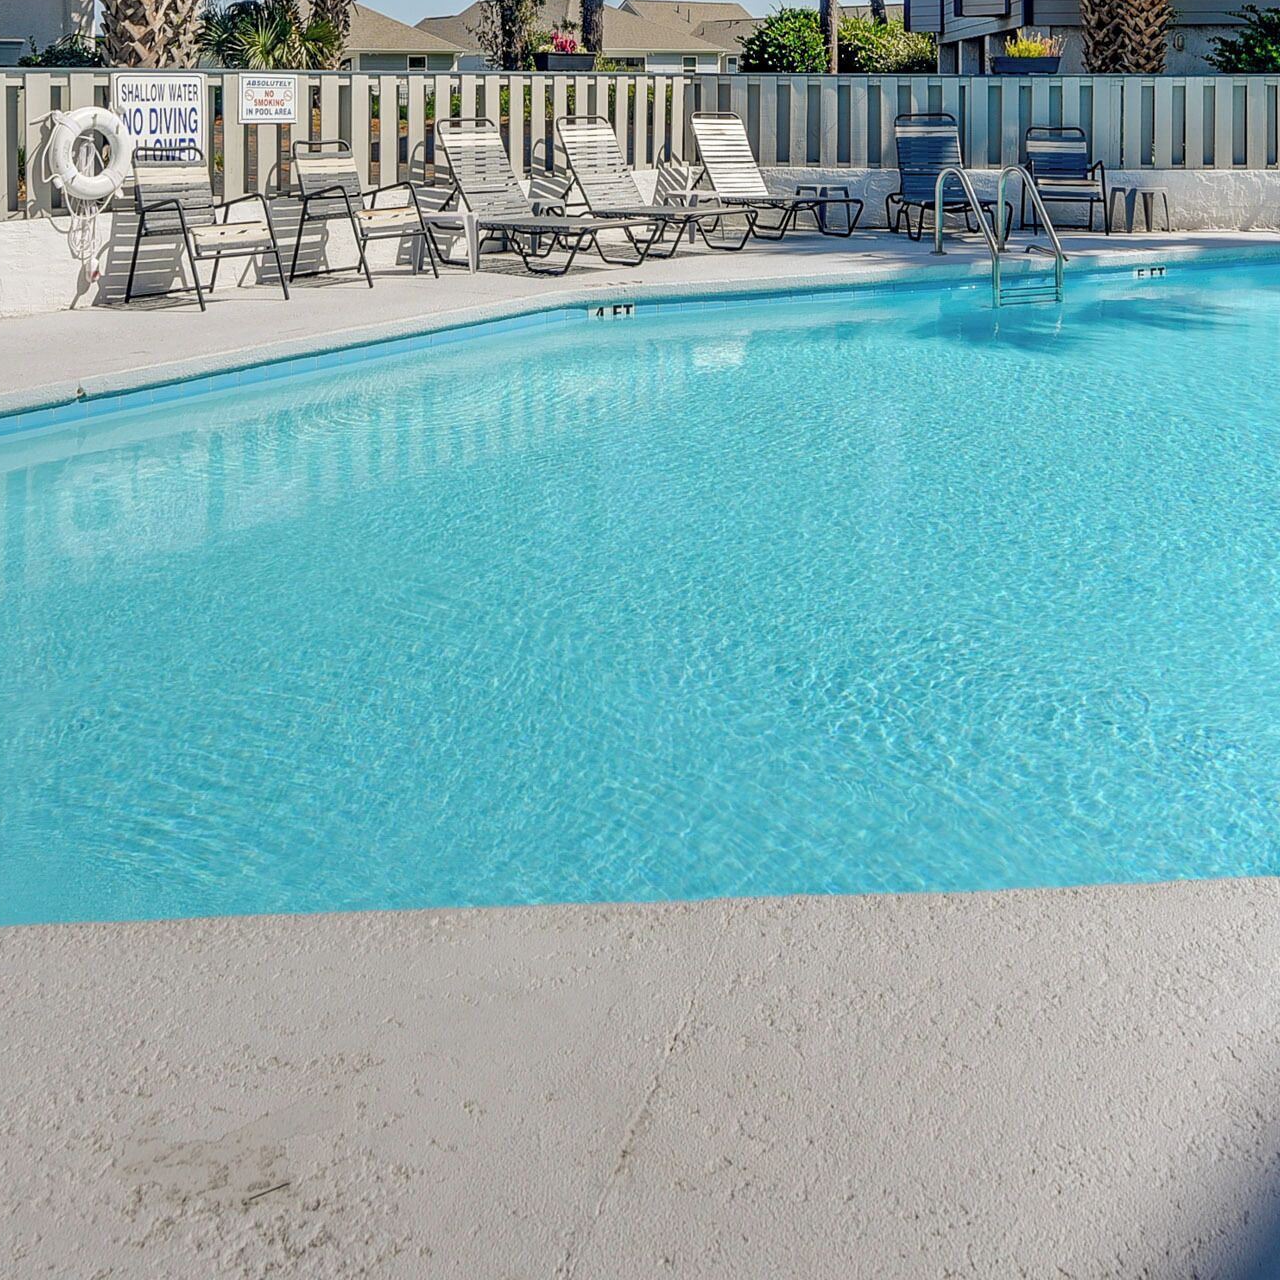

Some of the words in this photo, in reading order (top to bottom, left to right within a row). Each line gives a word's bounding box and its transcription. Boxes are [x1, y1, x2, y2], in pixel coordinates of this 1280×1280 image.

[121, 83, 164, 102] SHALLOW
[169, 83, 199, 102] WATER
[264, 90, 274, 98] NO
[254, 99, 285, 107] SMOKING
[122, 108, 143, 135] NO
[149, 107, 199, 135] DIVING
[613, 304, 633, 317] FT
